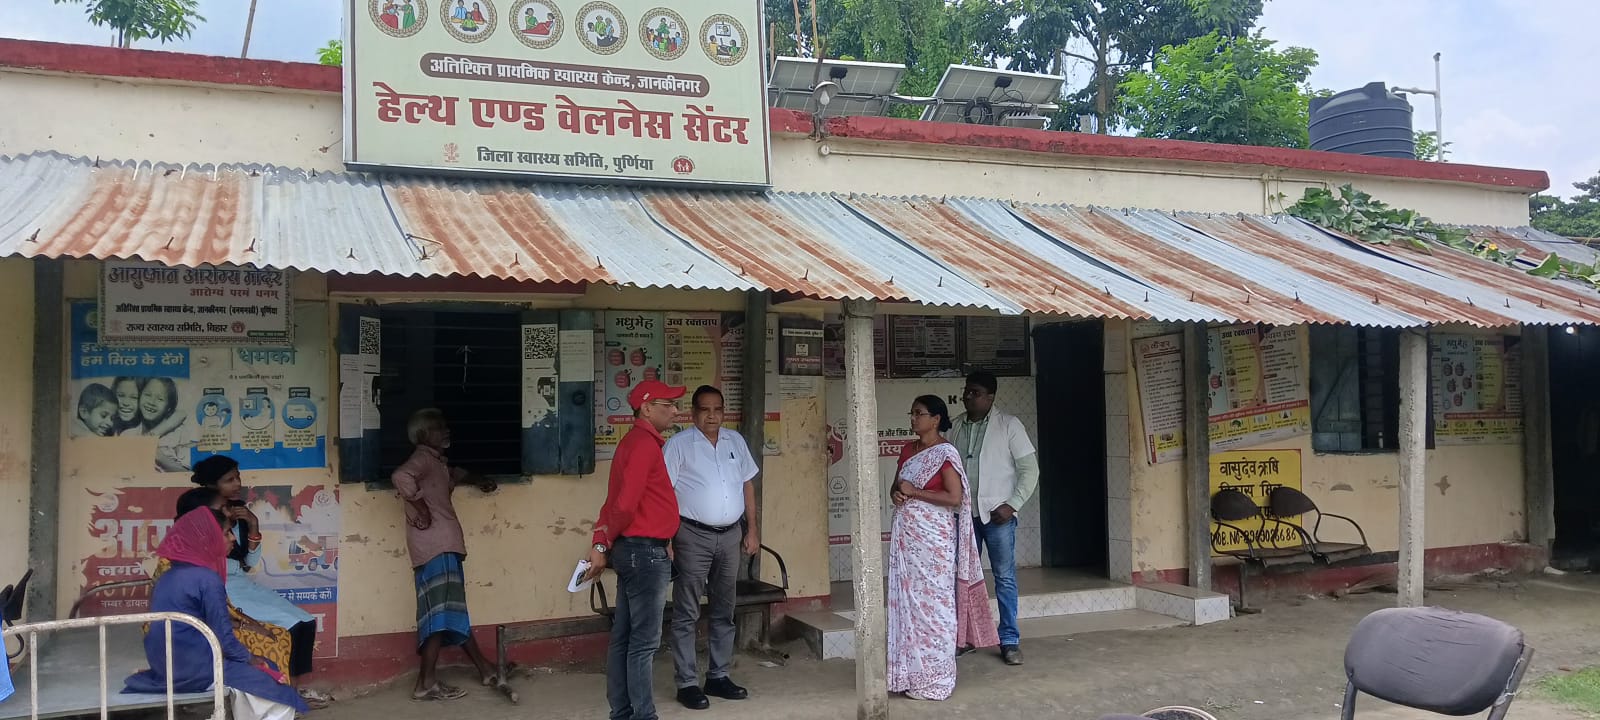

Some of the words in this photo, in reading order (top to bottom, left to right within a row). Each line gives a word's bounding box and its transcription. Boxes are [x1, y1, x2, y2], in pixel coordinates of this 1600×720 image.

[430, 56, 493, 76] अतिरिक्त
[496, 62, 550, 80] प्राथमिक
[553, 69, 599, 85] स्वास्थ्य
[637, 74, 702, 93] जानकीनगर
[373, 82, 459, 126] हेल्थ
[469, 98, 547, 131] एण्ड
[555, 94, 673, 140] वेलनेस
[682, 104, 750, 145] सेंटर
[477, 146, 513, 163] जिला
[516, 150, 560, 167] स्वास्थ्य
[563, 152, 608, 171] समिति,
[110, 267, 180, 290] आयुष्मान
[616, 315, 654, 330] मधुमेह
[667, 318, 682, 326] उच्च
[80, 355, 103, 366] हम
[108, 352, 138, 366] मिल
[142, 352, 157, 366] के
[1220, 457, 1257, 481] वासुदेव
